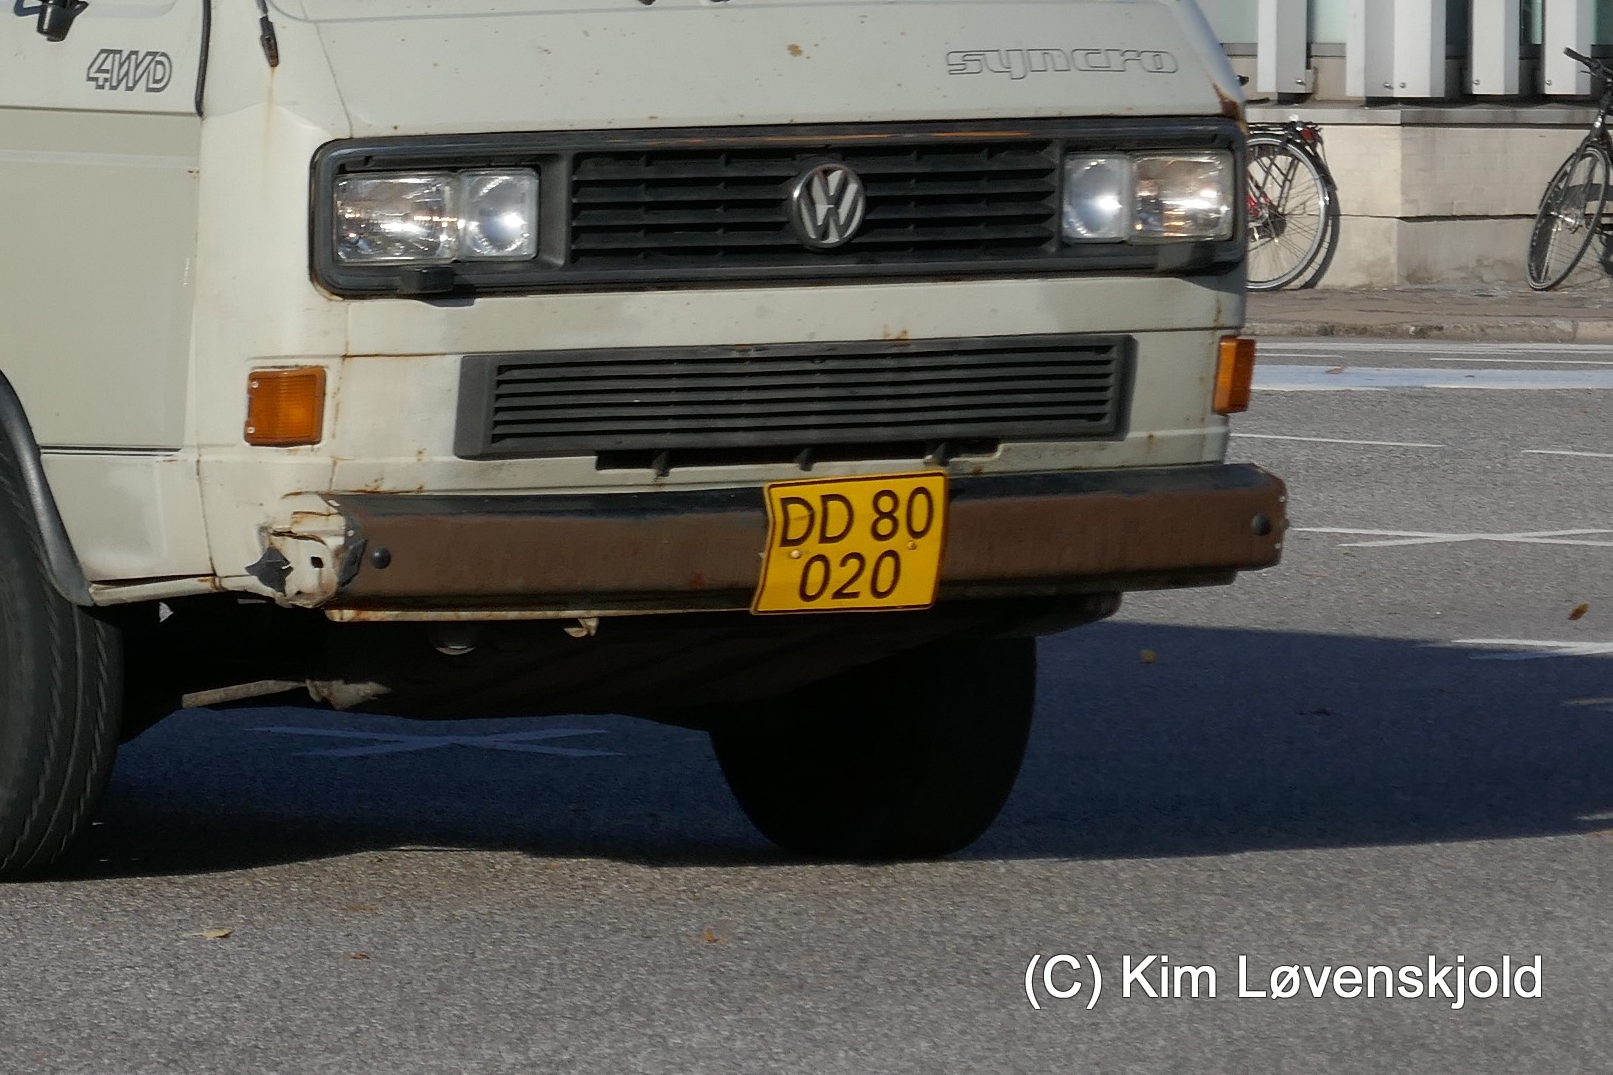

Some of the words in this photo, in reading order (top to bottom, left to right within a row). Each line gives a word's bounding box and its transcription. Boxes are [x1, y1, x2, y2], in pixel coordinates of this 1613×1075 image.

[86, 48, 173, 93] 4WD
[946, 48, 1178, 80] syncro
[779, 493, 854, 548] DD
[871, 486, 934, 542] 80
[799, 549, 901, 603] 020
